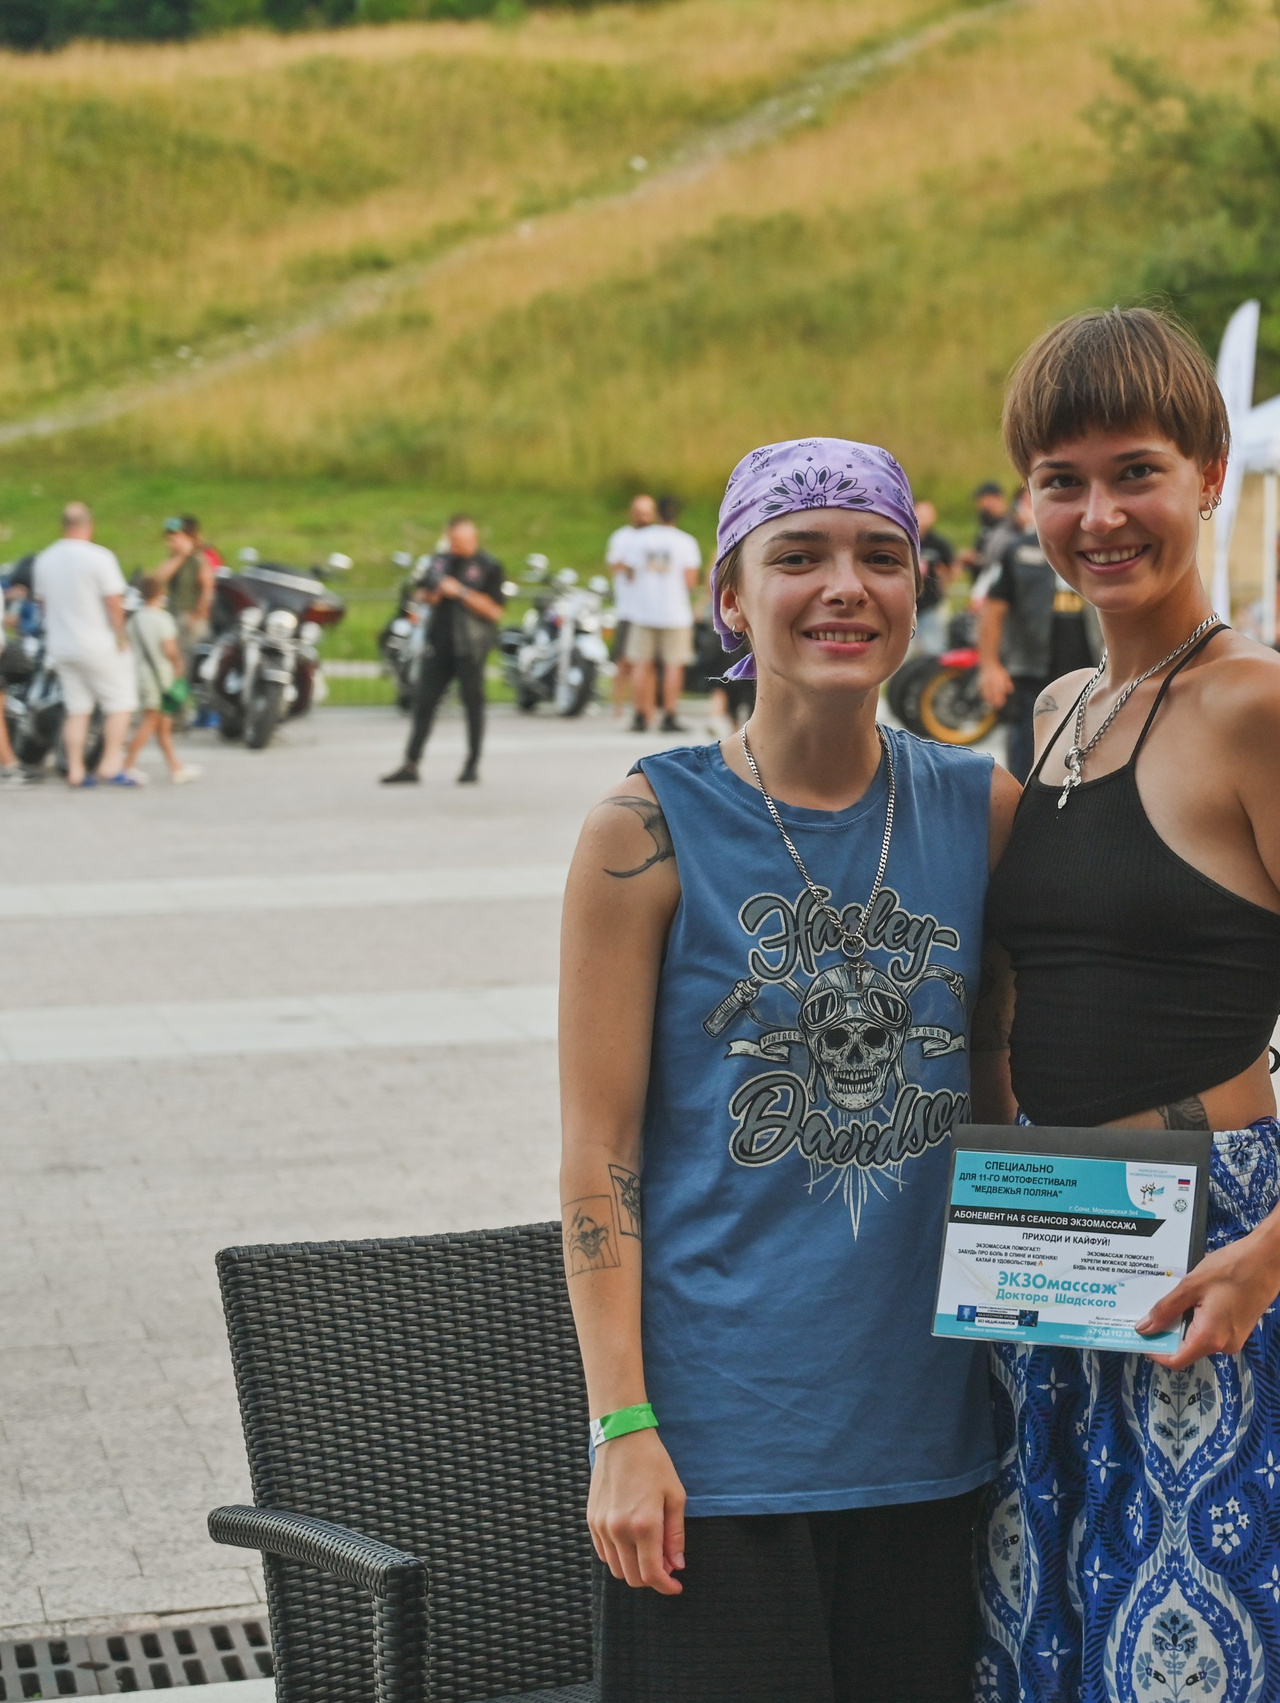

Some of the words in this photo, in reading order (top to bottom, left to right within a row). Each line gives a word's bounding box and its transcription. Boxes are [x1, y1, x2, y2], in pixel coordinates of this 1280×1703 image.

[762, 1031, 798, 1046] VINTAGE
[915, 1027, 948, 1040] POWER
[984, 1160, 1054, 1174] СПЕЦИАЛЬНО
[959, 1172, 977, 1181] ДЛЯ
[979, 1173, 1000, 1182] 11-ГО
[1001, 1174, 1078, 1187] МОТОФЕСТИВАЛЯ
[971, 1184, 1022, 1196] "МЕДВЕЖЬЯ
[1023, 1187, 1063, 1198] ПОЛЯНА"
[1092, 1206, 1128, 1215] Московская
[953, 1209, 1006, 1221] АБОНЕМЕНТ
[1006, 1213, 1019, 1222] НА
[1020, 1214, 1026, 1222] 5
[1027, 1214, 1069, 1226] СЕАНСОВ
[1070, 1217, 1137, 1231] ЭКЗОМАССАЖА
[1022, 1232, 1063, 1243] ПРИХОДИ
[1064, 1235, 1071, 1243] И
[1072, 1235, 1111, 1246] КАЙФУЙ!
[975, 1242, 1011, 1250] ЭКЗОМАССАЖ
[1011, 1244, 1041, 1252] ПОМОГАЕТ!
[1086, 1250, 1123, 1259] ЭКЗОМАССАЖ
[1124, 1253, 1155, 1261] ПОМОГАЕТ!
[996, 1258, 1037, 1267] УДОВОЛЬСТВИЕ
[1102, 1259, 1127, 1267] МУЖСКОЕ
[1137, 1269, 1165, 1277] СИТУАЦИИ
[995, 1288, 1049, 1304] Доктора
[1054, 1292, 1117, 1308] Шадского
